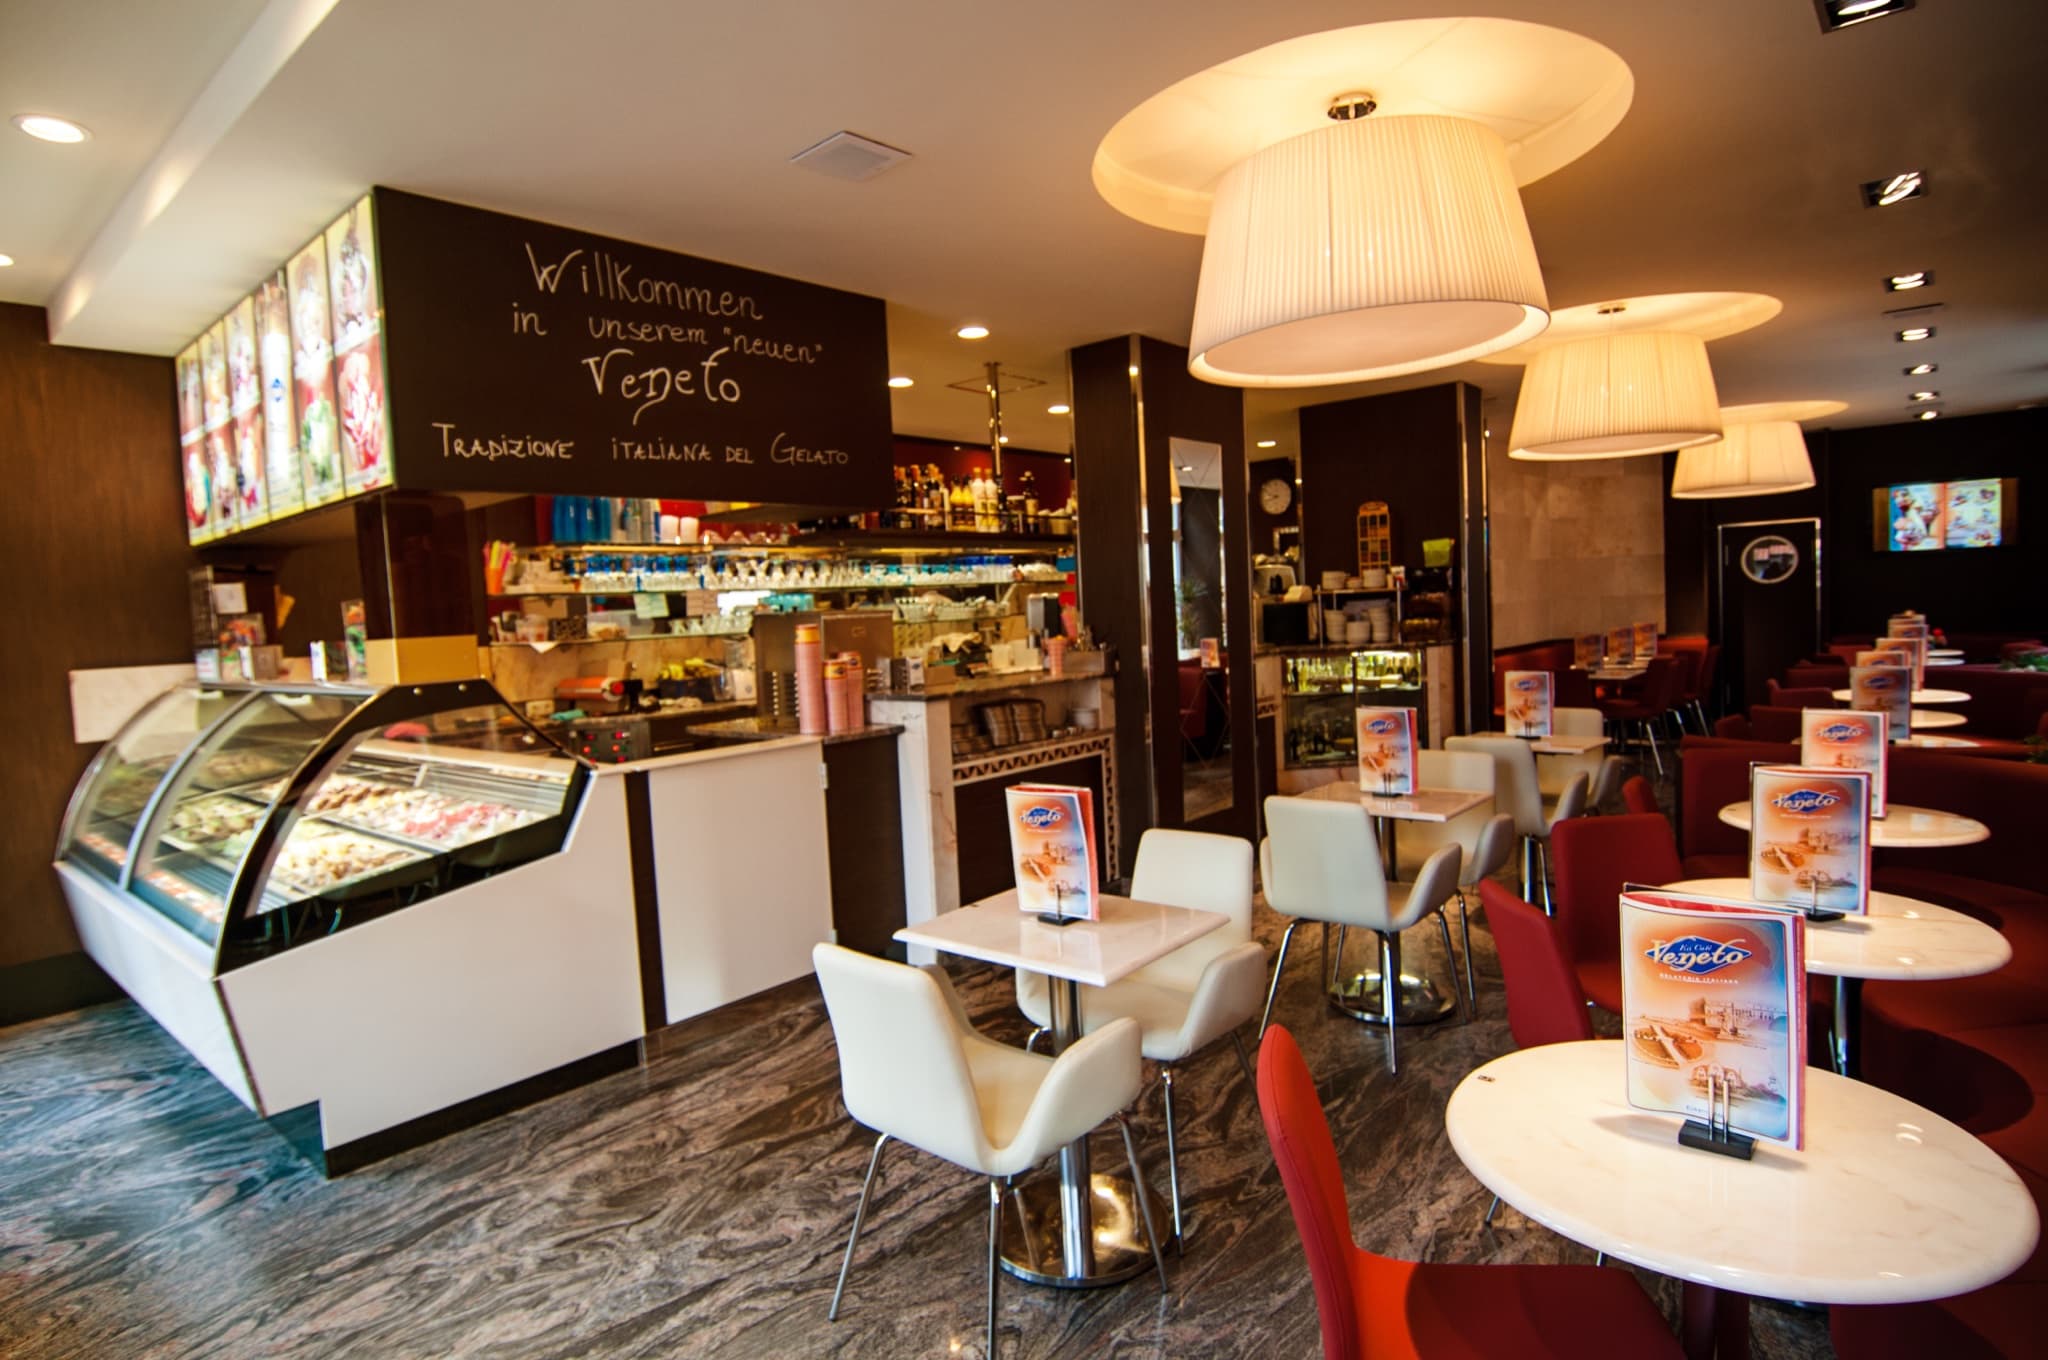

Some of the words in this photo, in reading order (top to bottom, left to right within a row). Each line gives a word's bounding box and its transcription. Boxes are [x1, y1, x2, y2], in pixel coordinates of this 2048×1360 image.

[512, 302, 547, 336] in
[588, 316, 708, 345] unserem
[582, 348, 741, 426] Veneto
[725, 447, 754, 465] DEL
[1651, 936, 1746, 972] Veneto
